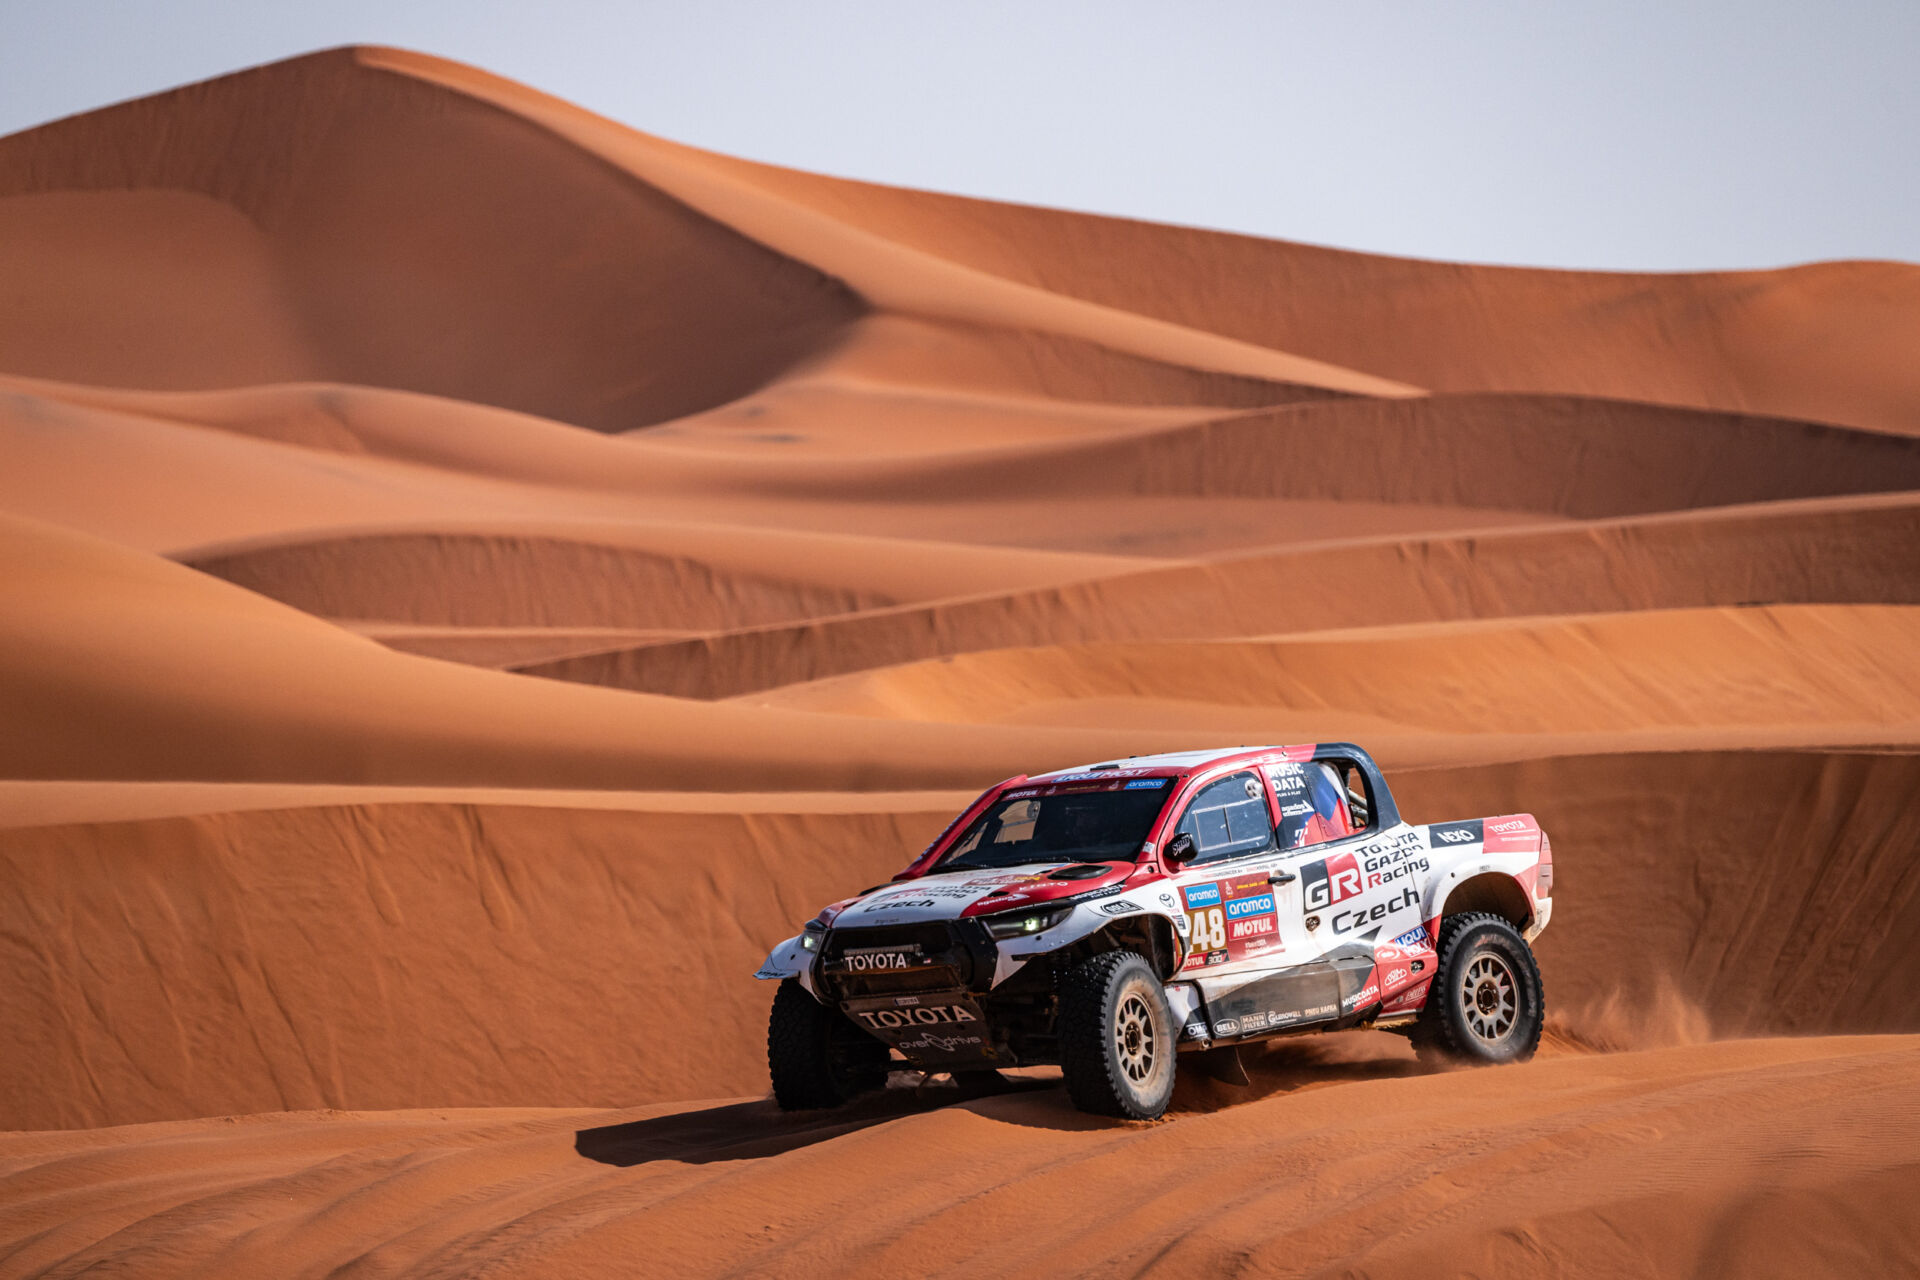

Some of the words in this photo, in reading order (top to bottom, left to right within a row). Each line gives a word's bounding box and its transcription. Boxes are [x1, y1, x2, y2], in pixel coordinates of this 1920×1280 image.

[1268, 762, 1304, 778] MUSIC
[1128, 779, 1162, 788] aramco
[1272, 776, 1305, 791] DATA
[1007, 789, 1037, 799] MOTUL
[1488, 820, 1526, 833] TOYOTA
[1355, 832, 1420, 857] TOOTA
[1367, 858, 1430, 889] Racing
[1188, 889, 1218, 902] aramco
[1305, 867, 1363, 910] GR
[864, 899, 936, 913] Czech
[1229, 897, 1271, 915] aramco
[1332, 888, 1421, 935] Czech
[1233, 918, 1273, 937] MOTUL
[845, 953, 907, 972] TOYOTA
[1342, 985, 1379, 1008] MUSICDATA
[858, 1005, 977, 1029] TOYOTA
[1242, 1014, 1265, 1023] MANN
[1216, 1021, 1237, 1032] BELL
[1243, 1021, 1266, 1030] FILTER
